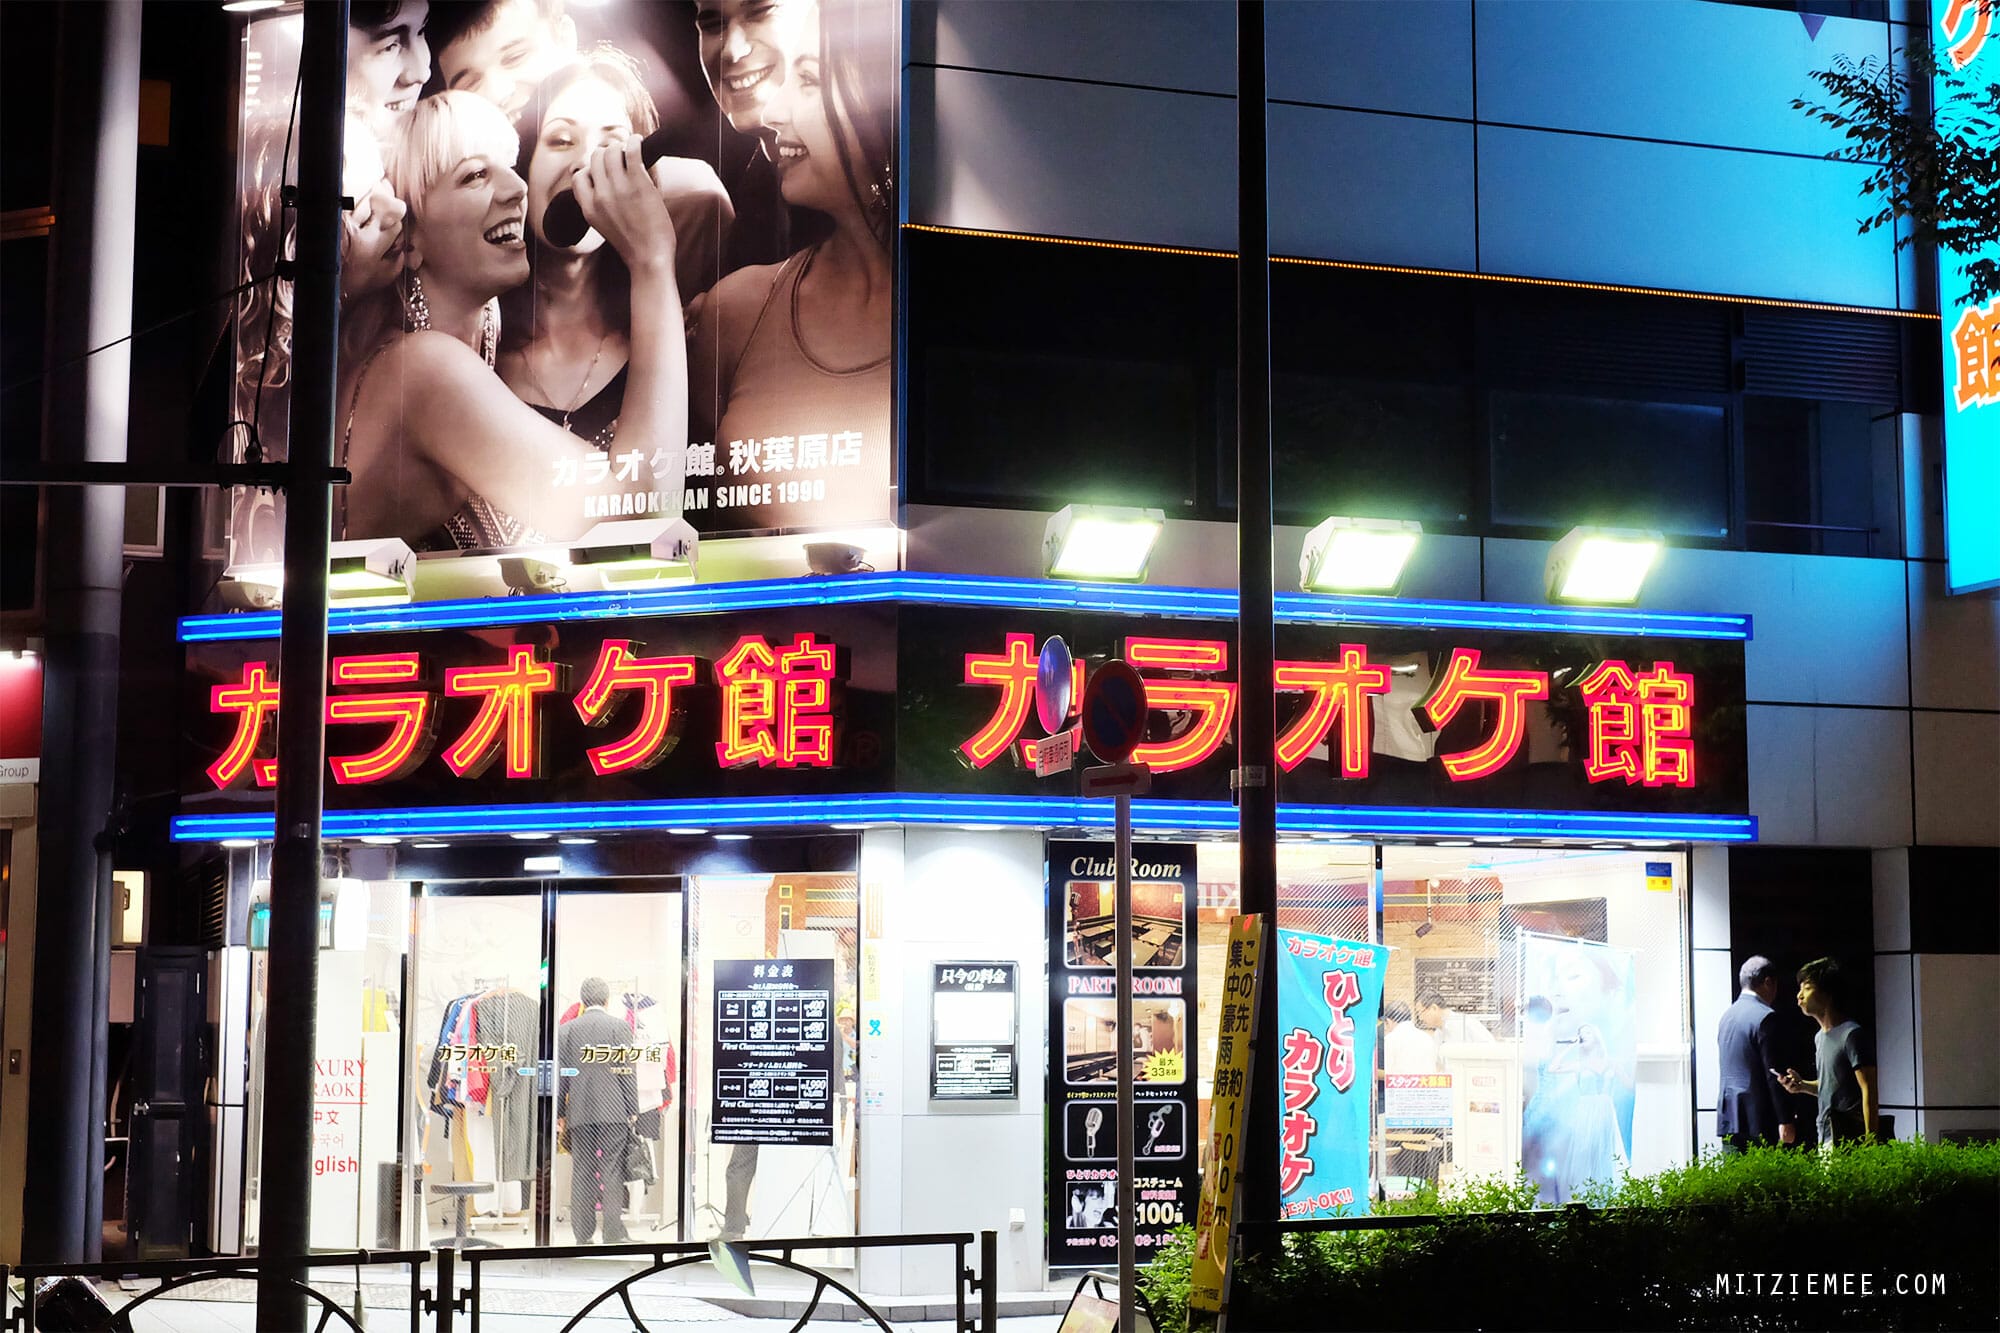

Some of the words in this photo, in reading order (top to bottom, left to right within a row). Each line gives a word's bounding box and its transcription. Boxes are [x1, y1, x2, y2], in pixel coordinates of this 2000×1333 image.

[552, 442, 716, 487] カラオケ館
[729, 430, 863, 475] 秋葉原店
[584, 487, 709, 518] KARAOKEKAN
[716, 483, 772, 508] SINCE
[206, 632, 837, 790] カラオケ館
[958, 632, 1697, 788] カラオケ館
[1070, 856, 1116, 876] Club
[1287, 937, 1372, 968] カラオケ館
[940, 968, 1008, 984] 只今の料金
[1067, 975, 1117, 994] PART
[1237, 940, 1255, 1033] この先
[1215, 939, 1243, 1098] 集中豪雨時
[1323, 969, 1361, 1092] ひとり
[438, 1043, 517, 1062] カラオケ館
[580, 1043, 662, 1063] カラオケ館
[314, 1110, 340, 1125] 中文
[1280, 1028, 1322, 1197] カラオケ
[1216, 1067, 1244, 1228] 約100m
[315, 1156, 358, 1176] glish
[1065, 1168, 1118, 1180] ひとりカラオ
[1133, 1177, 1183, 1188] コスチューム
